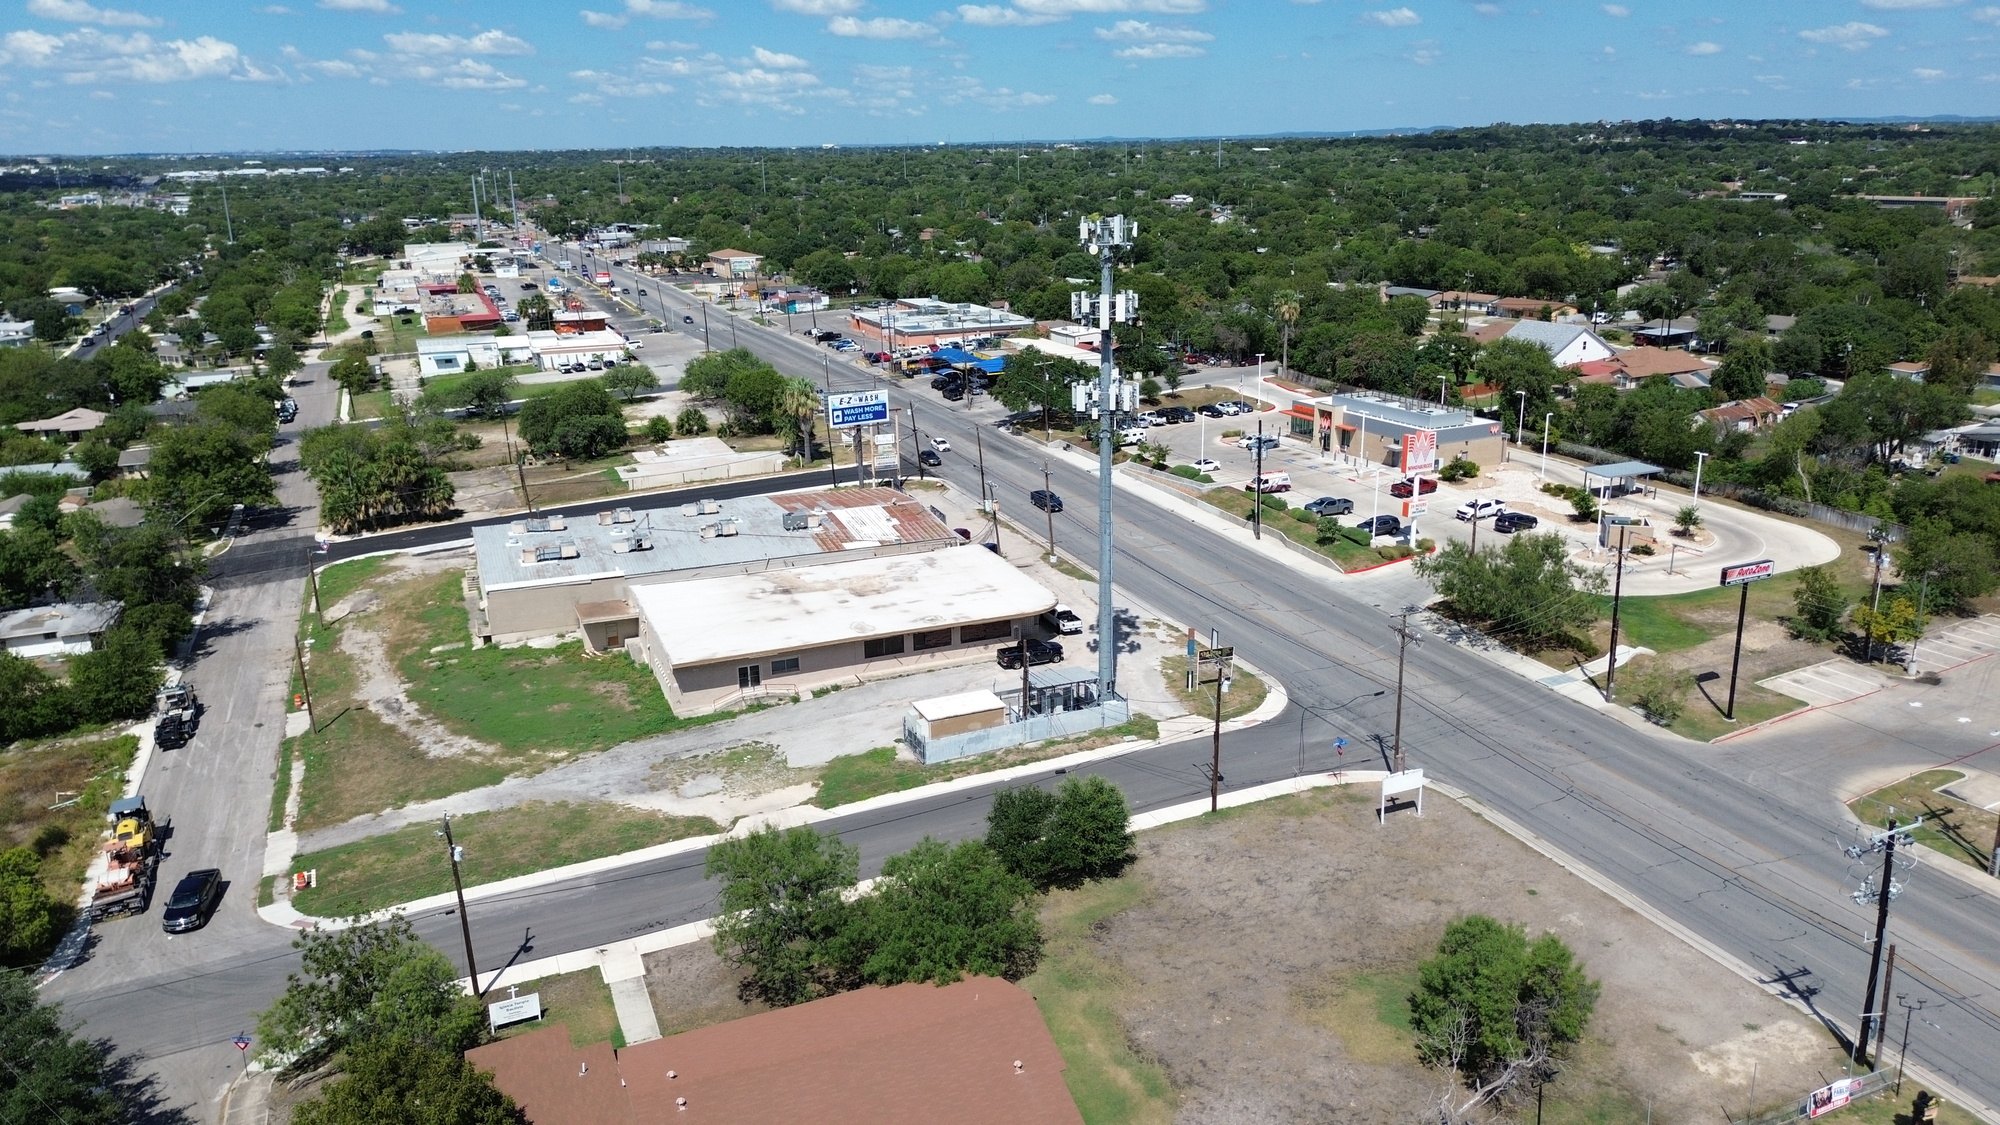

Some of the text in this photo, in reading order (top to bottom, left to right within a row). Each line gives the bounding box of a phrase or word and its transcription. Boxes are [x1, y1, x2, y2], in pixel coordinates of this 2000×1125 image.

[858, 394, 879, 403] WASH
[844, 407, 863, 416] WASH
[1736, 564, 1770, 577] AutoZone
